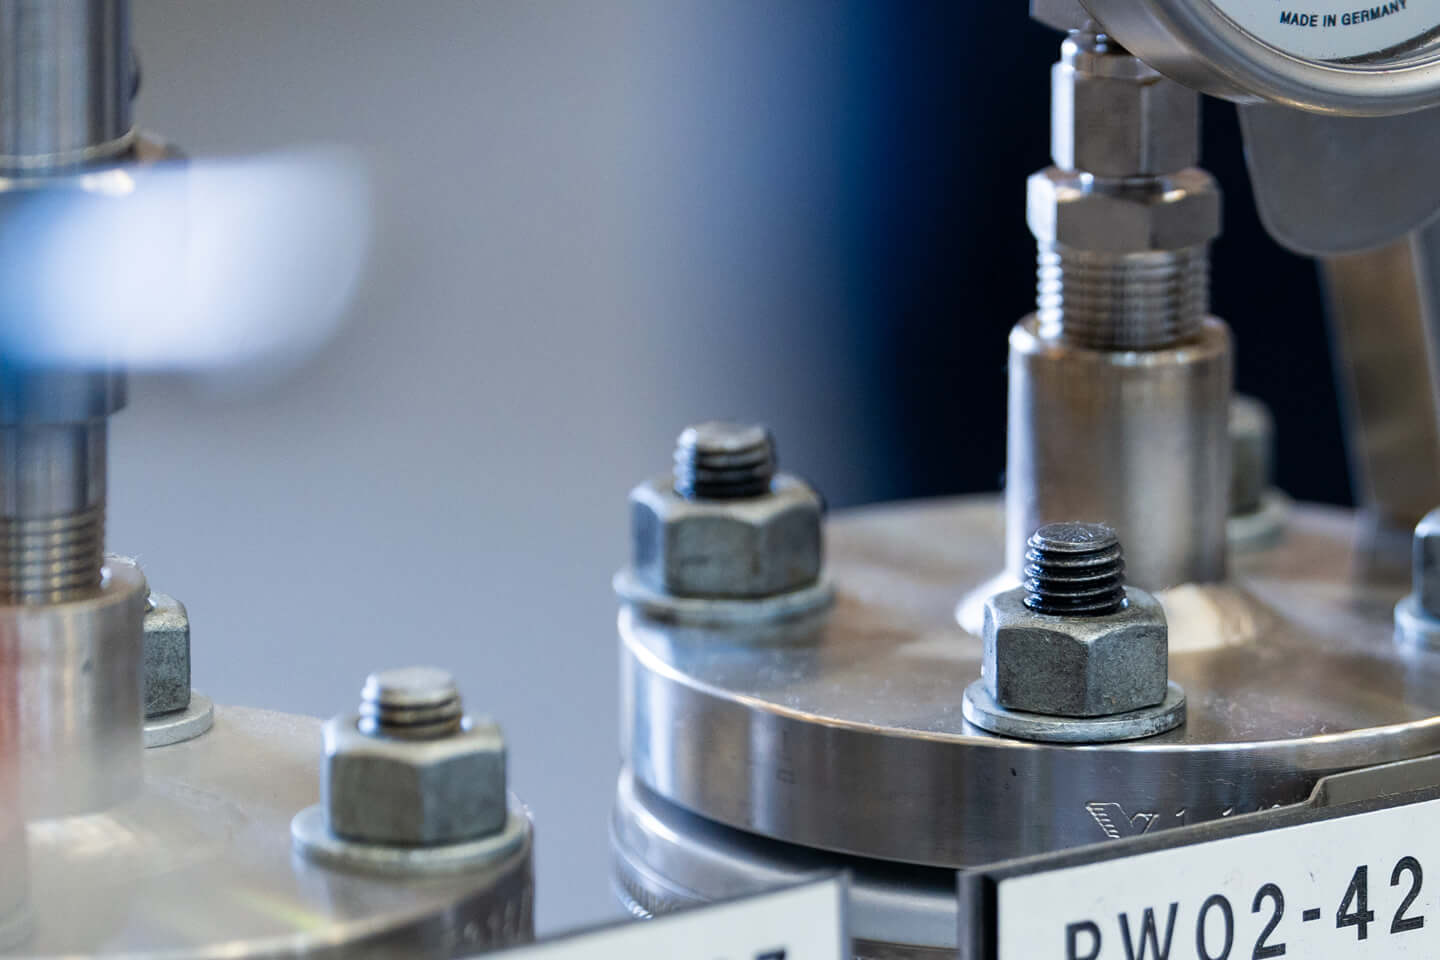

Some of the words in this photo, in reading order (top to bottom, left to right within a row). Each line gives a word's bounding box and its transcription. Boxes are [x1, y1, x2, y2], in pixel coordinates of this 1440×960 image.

[1279, 10, 1319, 27] MADE
[1322, 14, 1337, 28] IN
[1341, 0, 1408, 26] GERMANY
